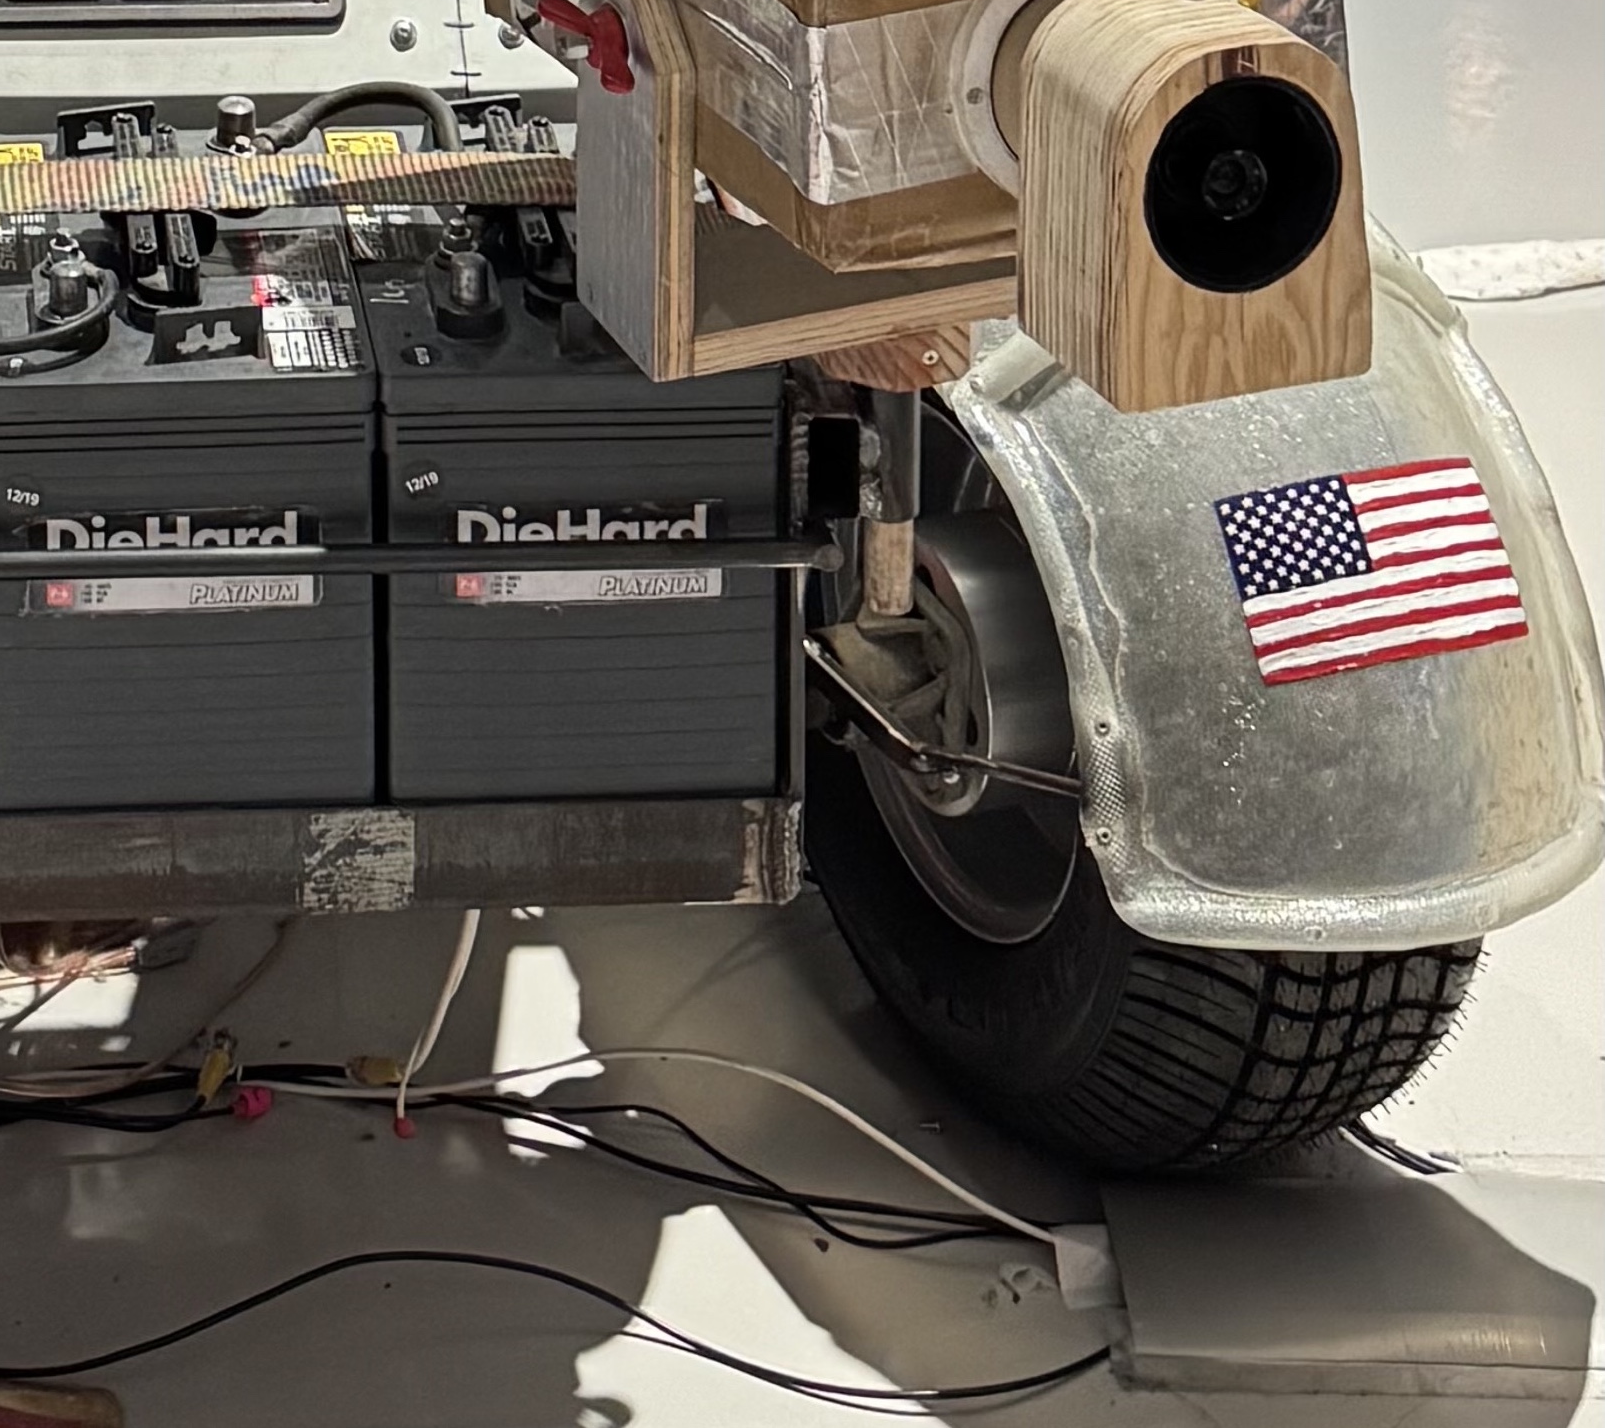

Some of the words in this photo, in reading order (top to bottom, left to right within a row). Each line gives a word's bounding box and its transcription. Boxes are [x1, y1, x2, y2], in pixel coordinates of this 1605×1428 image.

[6, 487, 40, 507] 12/19
[189, 583, 299, 605] PLATINUM
[598, 575, 708, 597] PLATINUM
